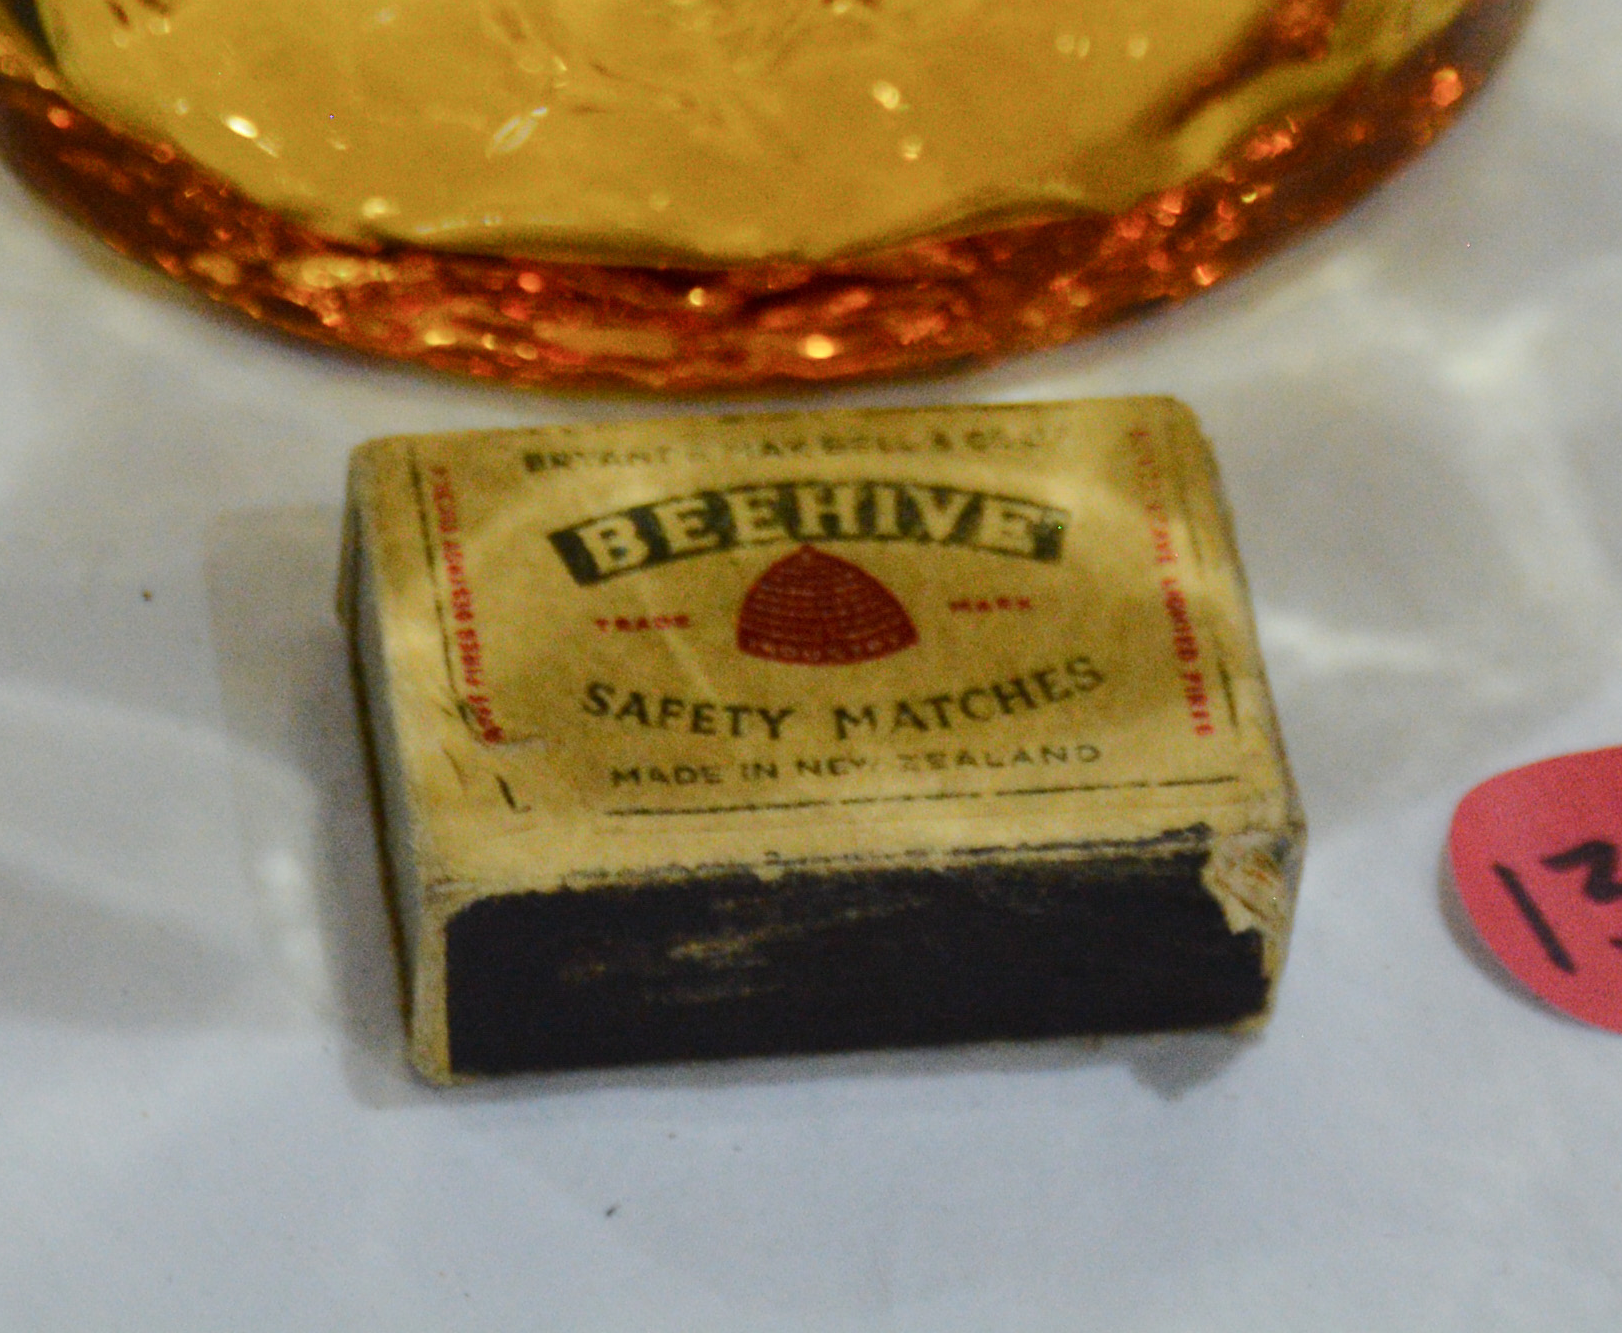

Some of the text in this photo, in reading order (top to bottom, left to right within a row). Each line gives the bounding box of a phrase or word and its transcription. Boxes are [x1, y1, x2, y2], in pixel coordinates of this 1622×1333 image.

[577, 484, 1037, 578] BEEHIVE
[594, 614, 691, 633] TRADE
[949, 597, 1032, 613] MARK
[582, 681, 796, 740] SAFETY
[831, 655, 1107, 740] MATCHES
[609, 764, 724, 788] MADE
[739, 760, 779, 781] IN
[895, 743, 1103, 774] ZEALAND
